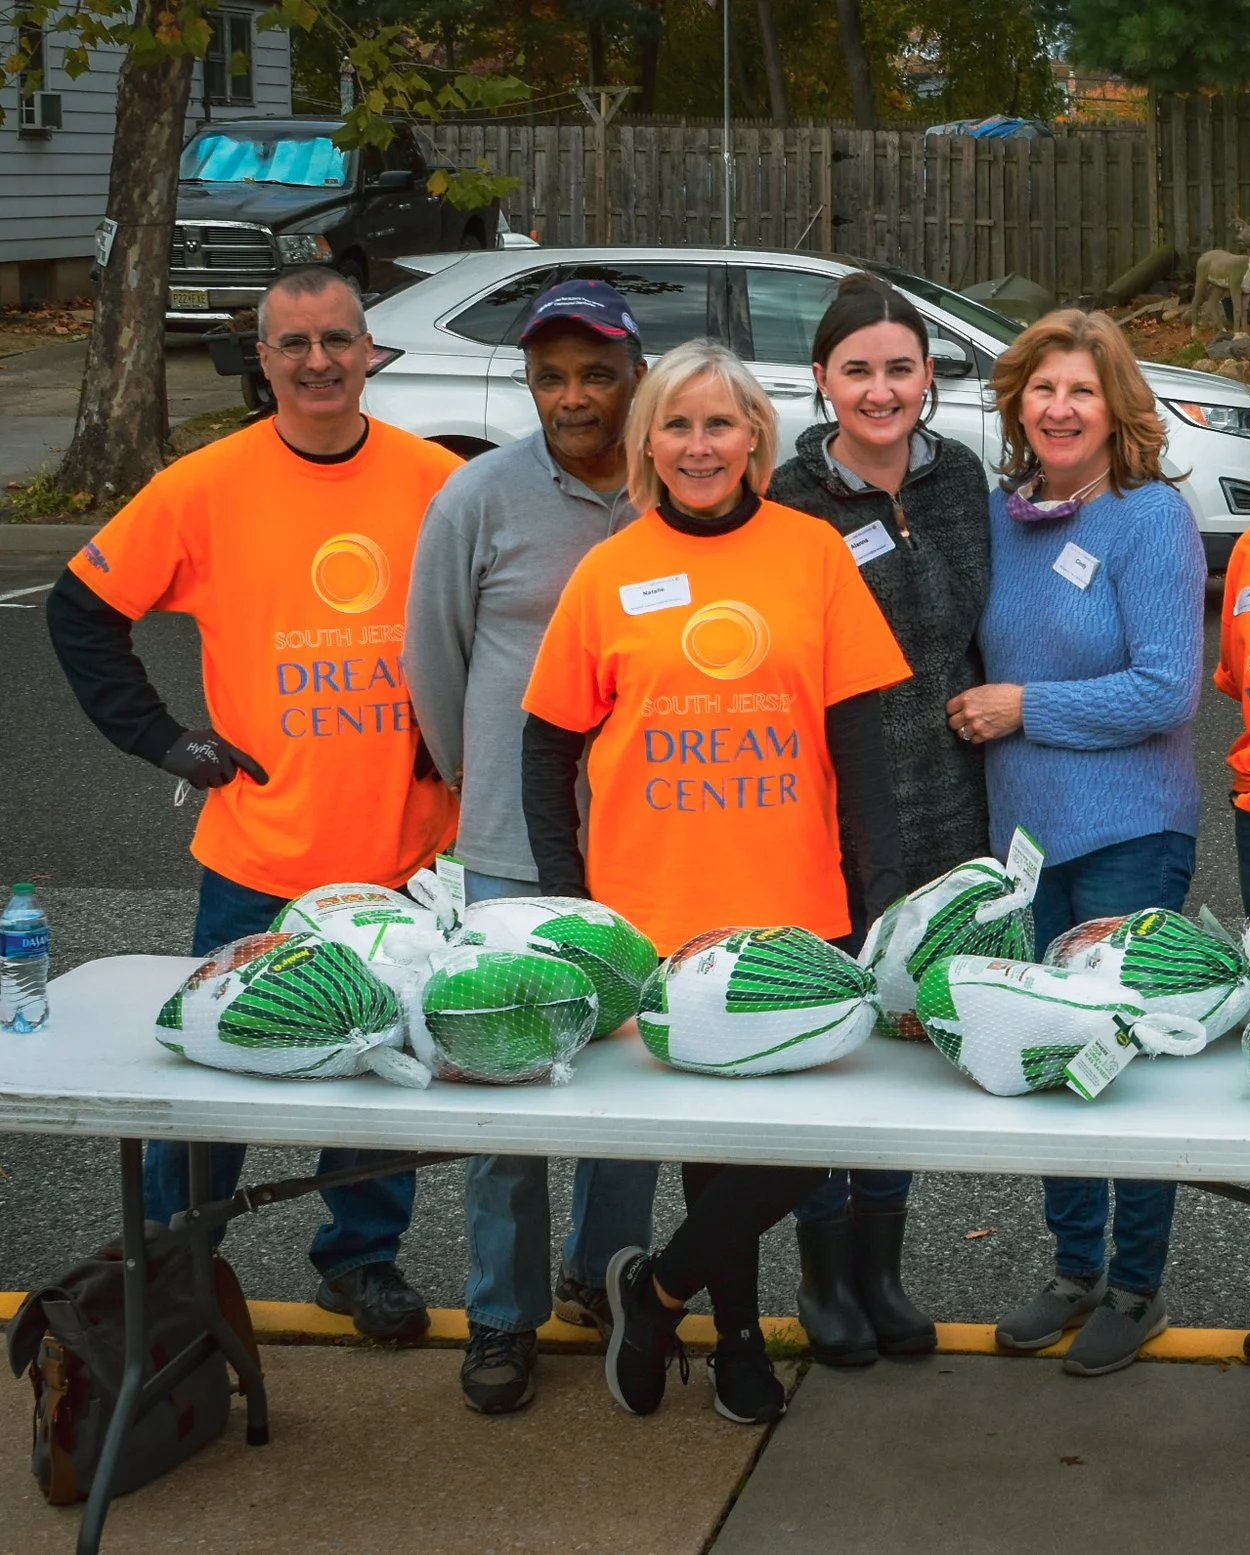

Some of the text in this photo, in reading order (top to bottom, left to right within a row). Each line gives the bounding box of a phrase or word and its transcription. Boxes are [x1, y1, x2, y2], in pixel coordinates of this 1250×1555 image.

[642, 587, 665, 597] Natalie
[274, 623, 405, 650] SOUTH JERS
[281, 701, 416, 738] CENTE
[640, 694, 720, 717] SOUTH
[644, 726, 799, 764] DREAM
[646, 772, 799, 811] CENTER
